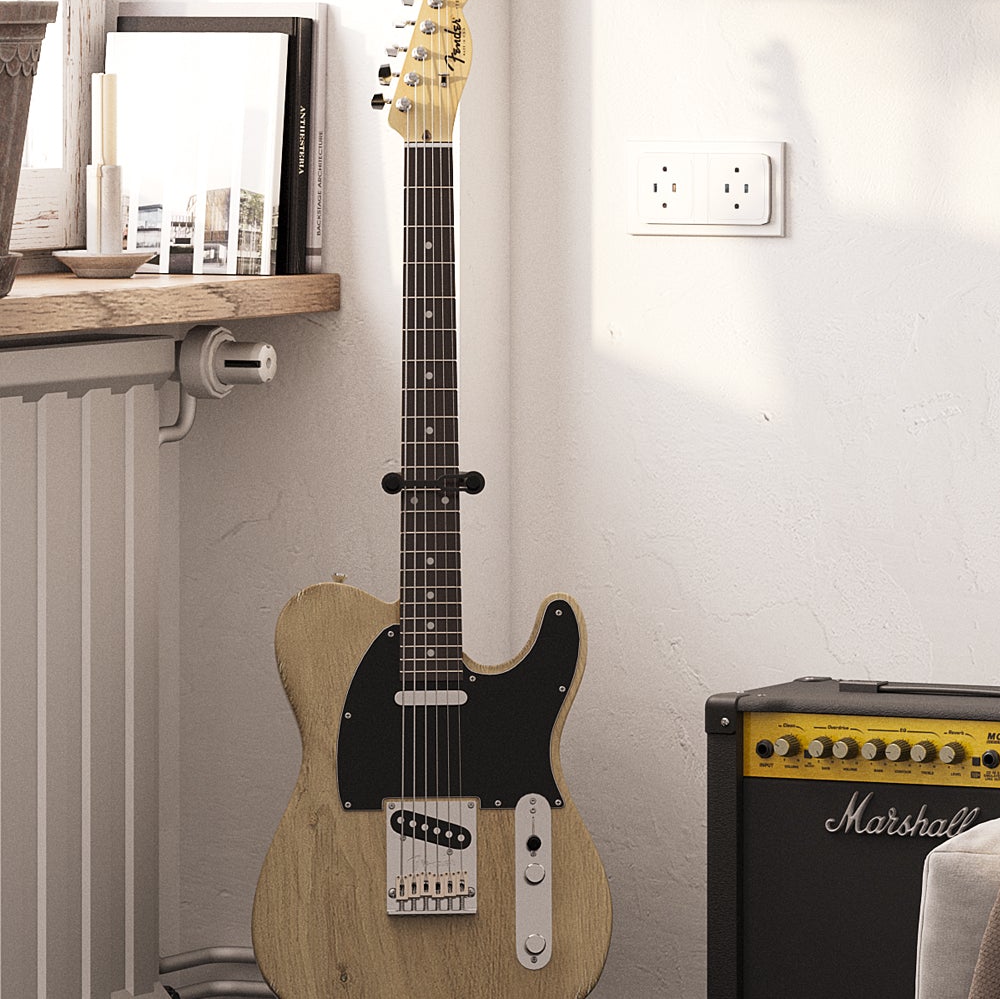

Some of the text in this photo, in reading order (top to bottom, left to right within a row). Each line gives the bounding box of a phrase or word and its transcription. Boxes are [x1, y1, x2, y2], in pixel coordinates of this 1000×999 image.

[444, 18, 466, 72] Fender
[298, 104, 306, 176] ANTHESTERIA
[316, 191, 324, 236] BACKSTAGE
[825, 790, 981, 838] Marshall
